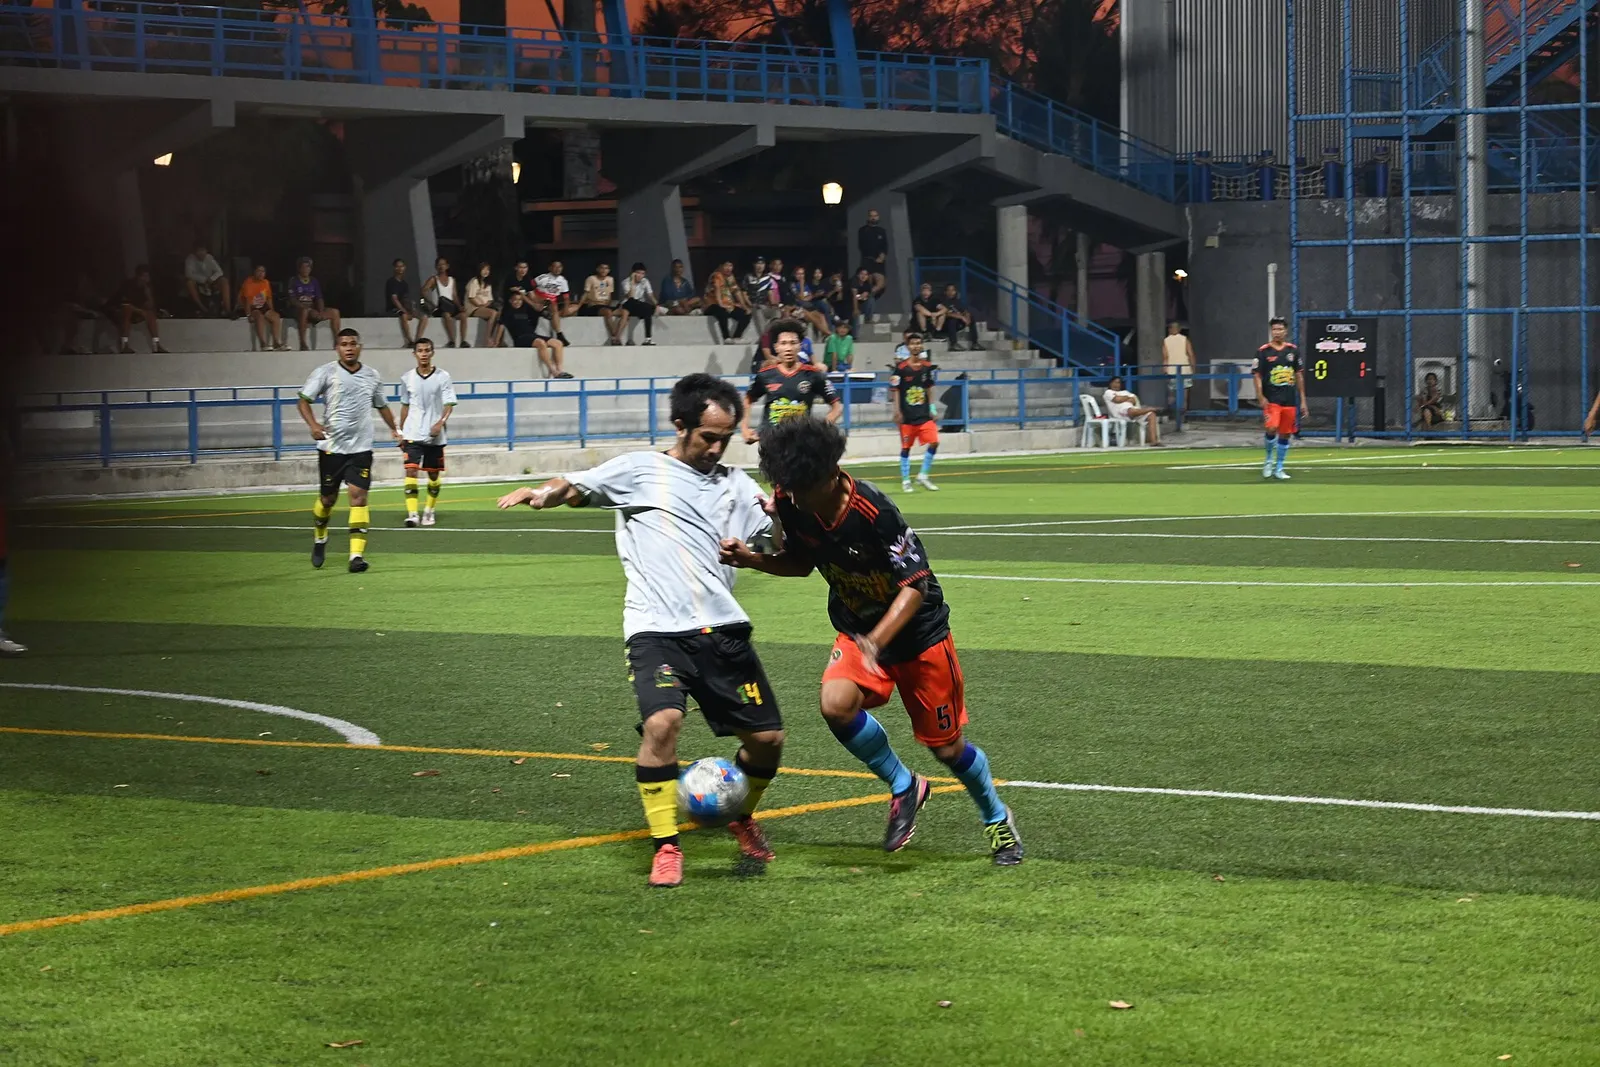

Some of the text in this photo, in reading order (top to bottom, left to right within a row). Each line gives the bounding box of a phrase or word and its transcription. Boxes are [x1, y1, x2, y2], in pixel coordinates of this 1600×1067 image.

[1315, 360, 1327, 380] 0
[1360, 361, 1366, 378] 1
[736, 682, 763, 706] 14
[936, 705, 952, 730] 5
